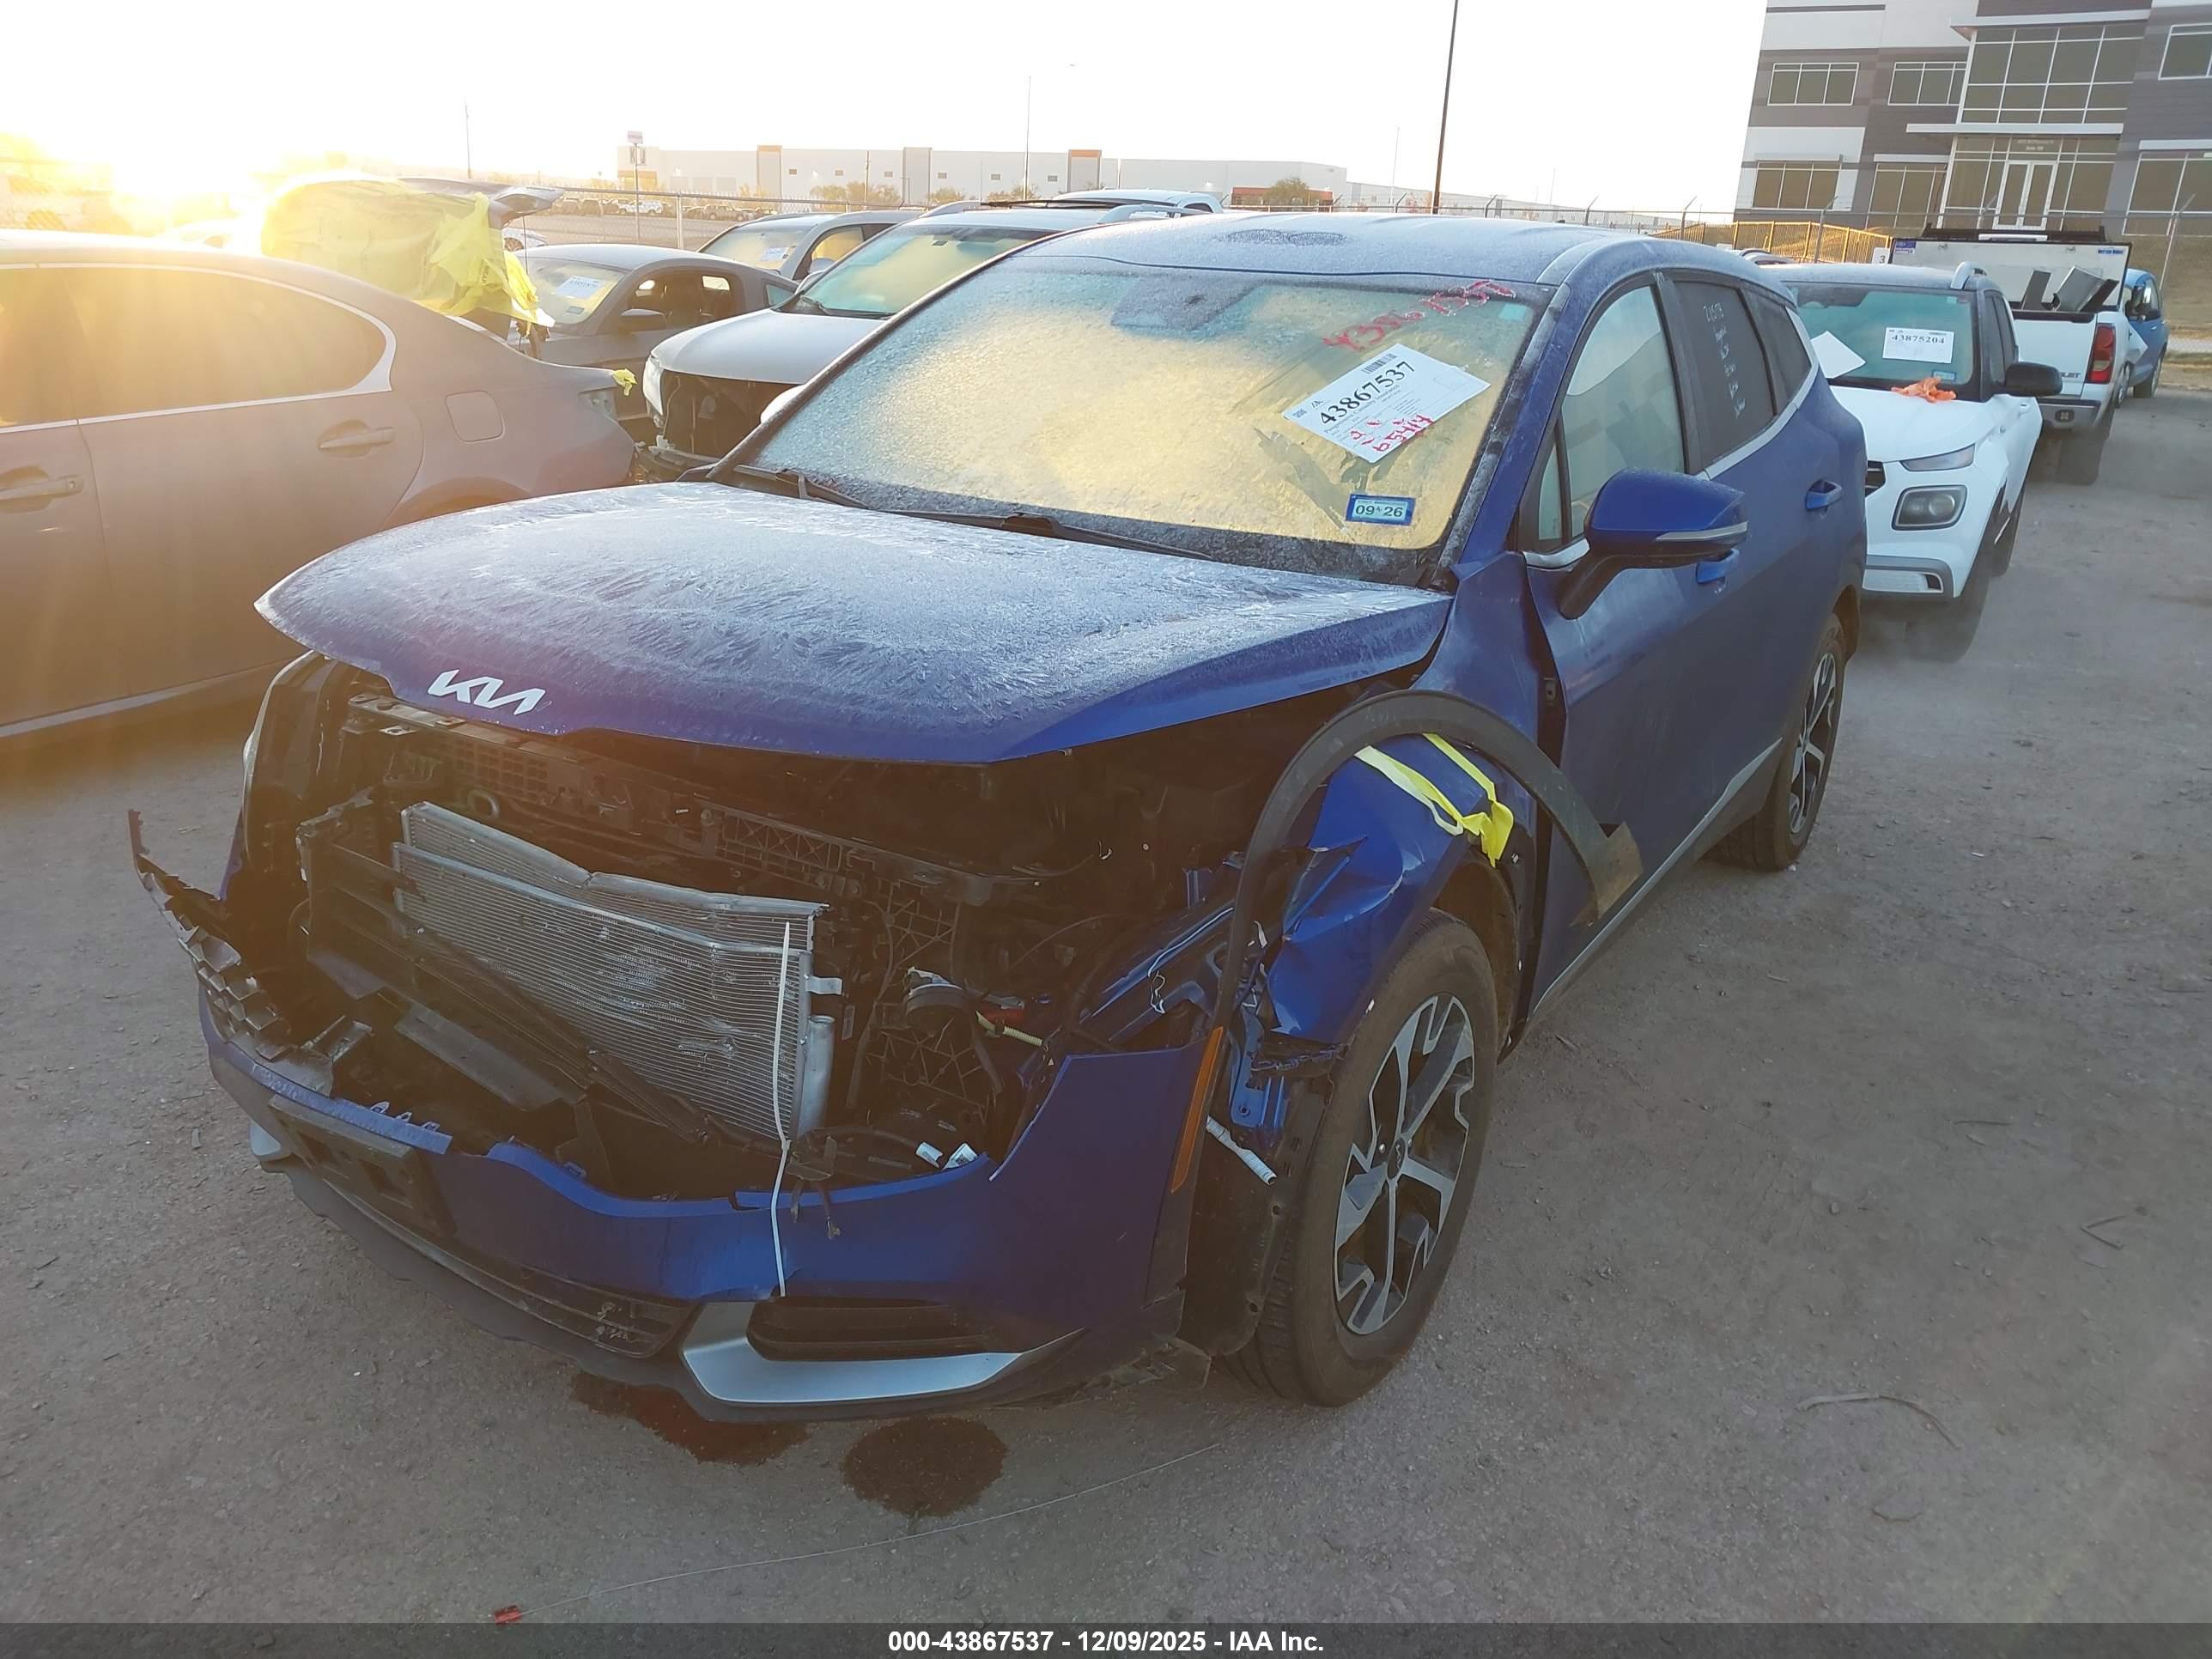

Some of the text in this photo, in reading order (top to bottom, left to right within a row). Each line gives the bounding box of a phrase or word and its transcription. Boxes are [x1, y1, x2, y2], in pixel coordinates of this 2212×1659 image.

[1891, 334, 1945, 344] 43875204
[1320, 360, 1415, 426] 43867537
[1355, 505, 1403, 517] 09 26
[428, 669, 547, 716] KIA
